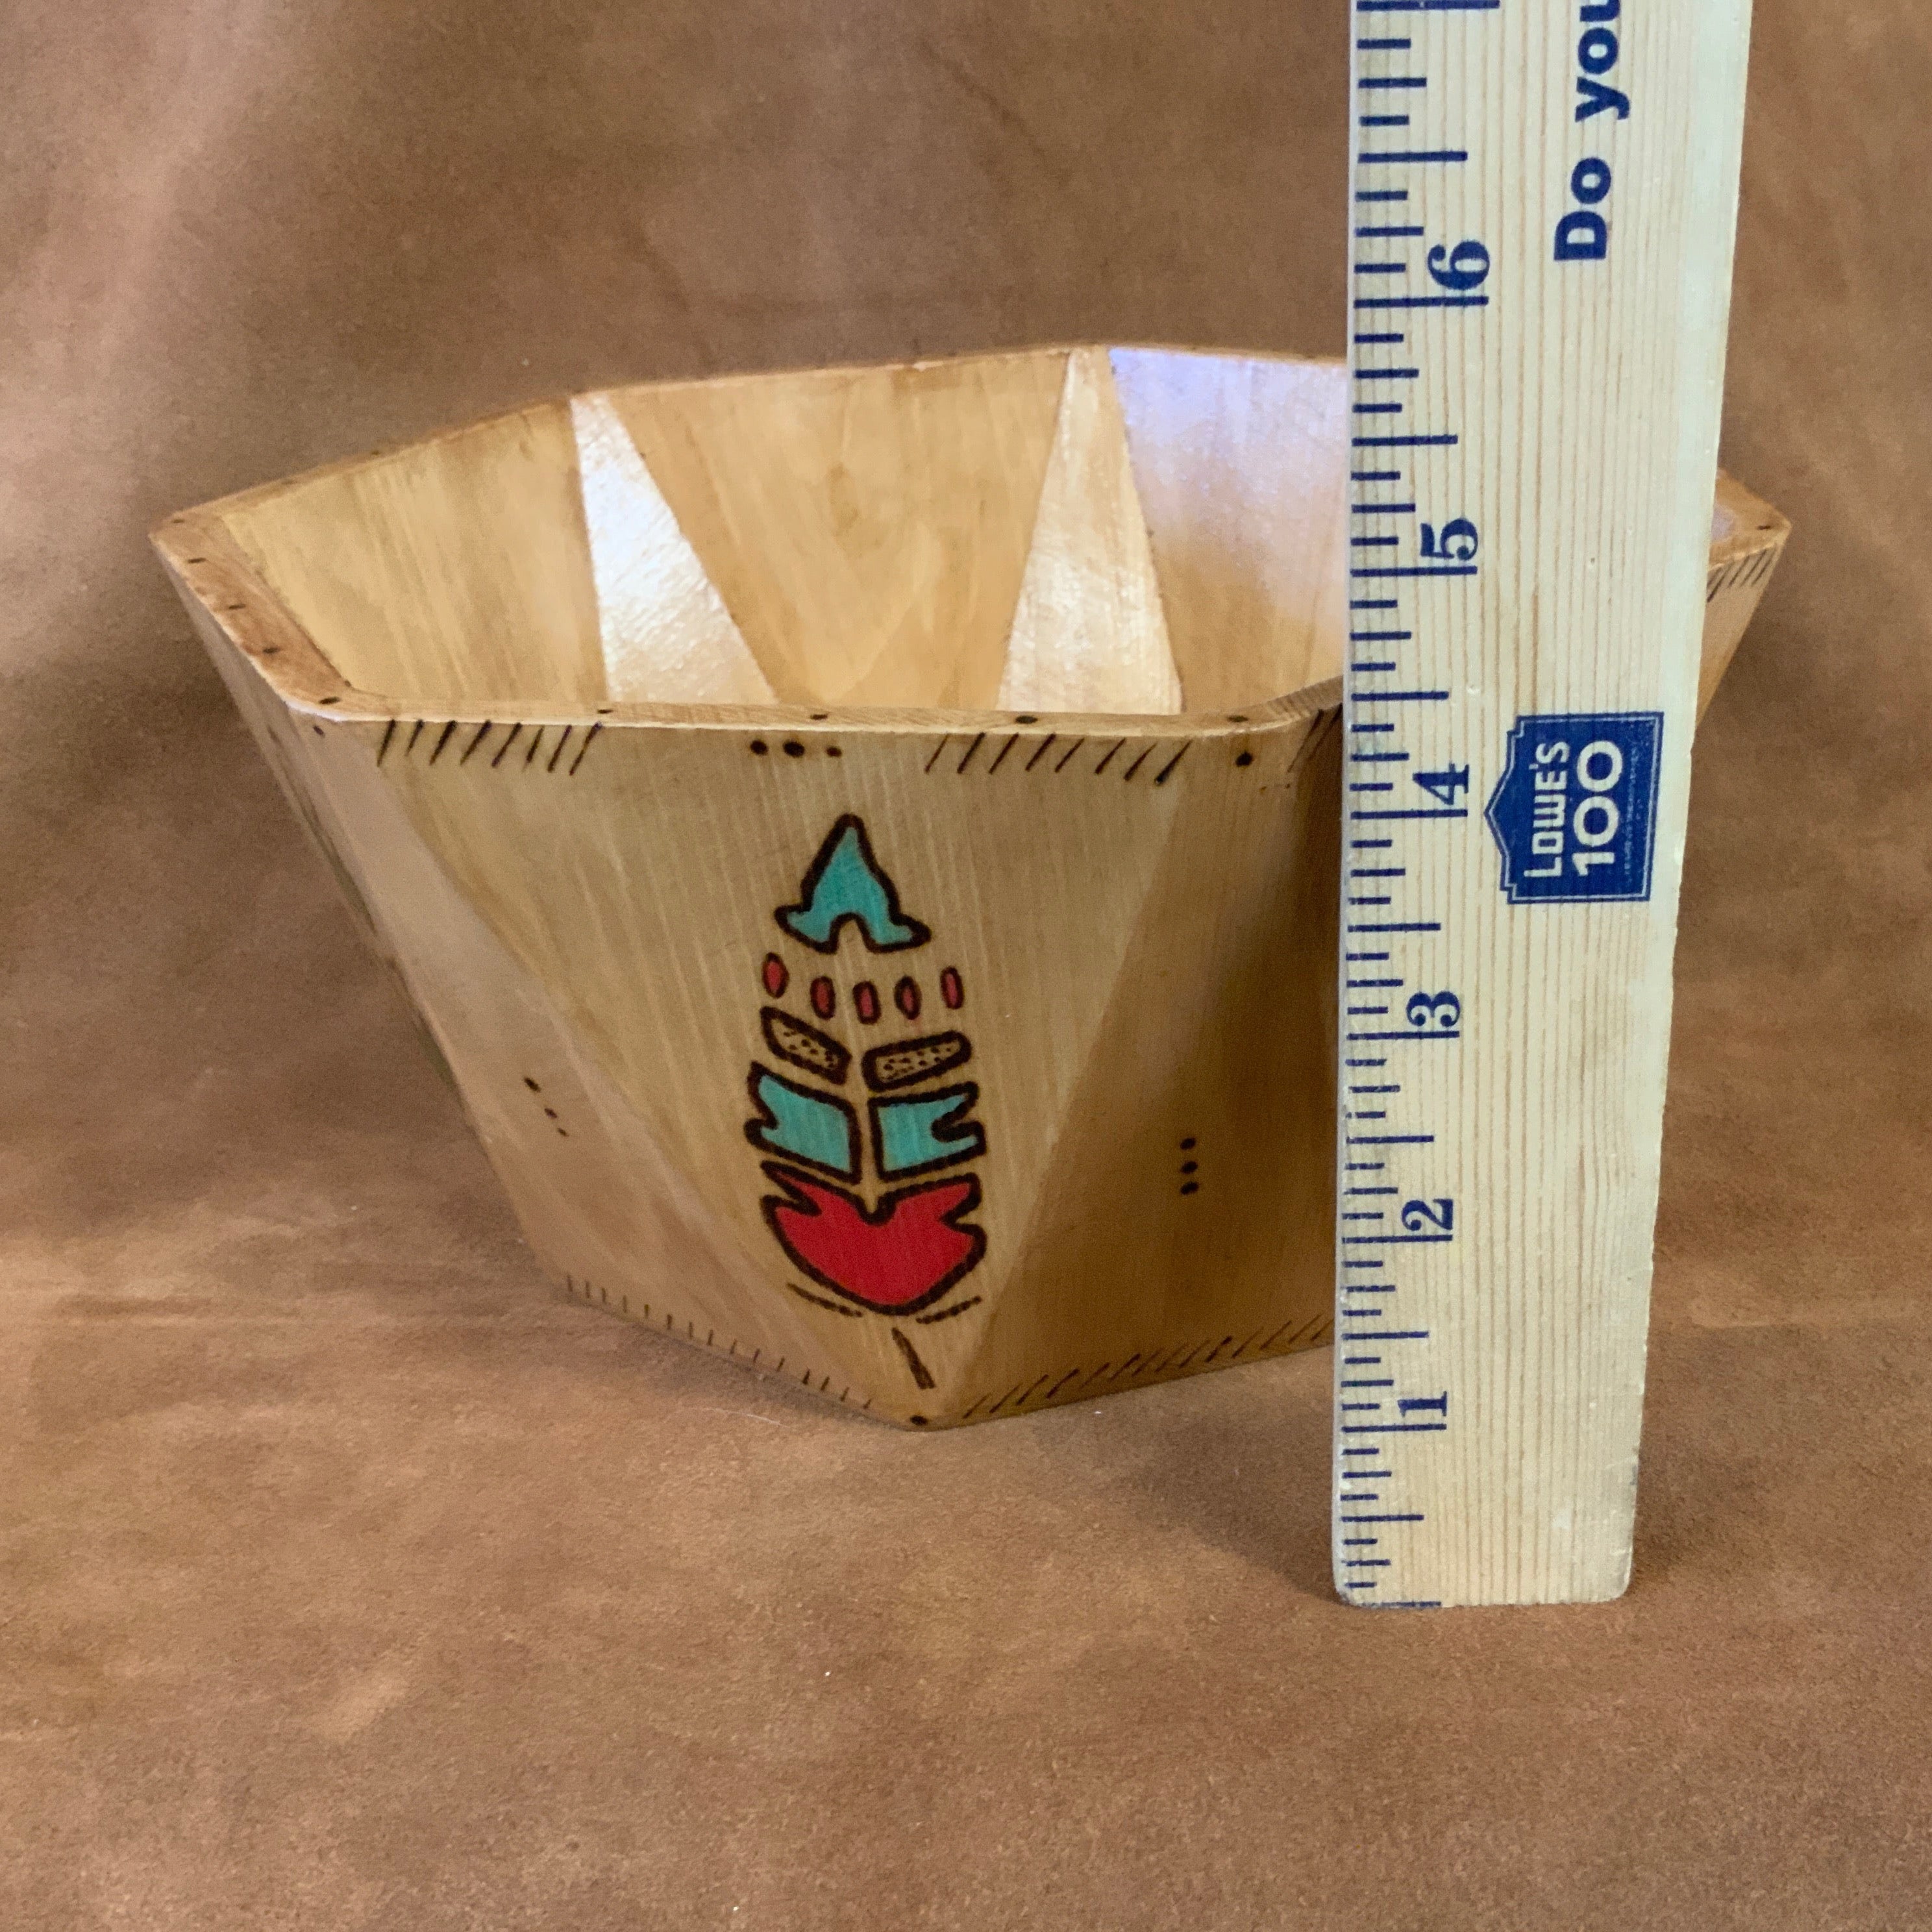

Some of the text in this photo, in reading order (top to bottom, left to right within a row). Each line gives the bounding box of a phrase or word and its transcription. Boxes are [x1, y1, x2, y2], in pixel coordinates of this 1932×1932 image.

[1554, 157, 1611, 261] Do
[1428, 240, 1490, 290] 6
[1420, 517, 1478, 561] 5
[1412, 763, 1470, 805] 4
[1524, 741, 1570, 878] LOWE'S
[1572, 740, 1623, 876] 100
[1406, 991, 1461, 1028] 3
[1400, 1198, 1454, 1232] 2
[1397, 1391, 1448, 1417] 1
